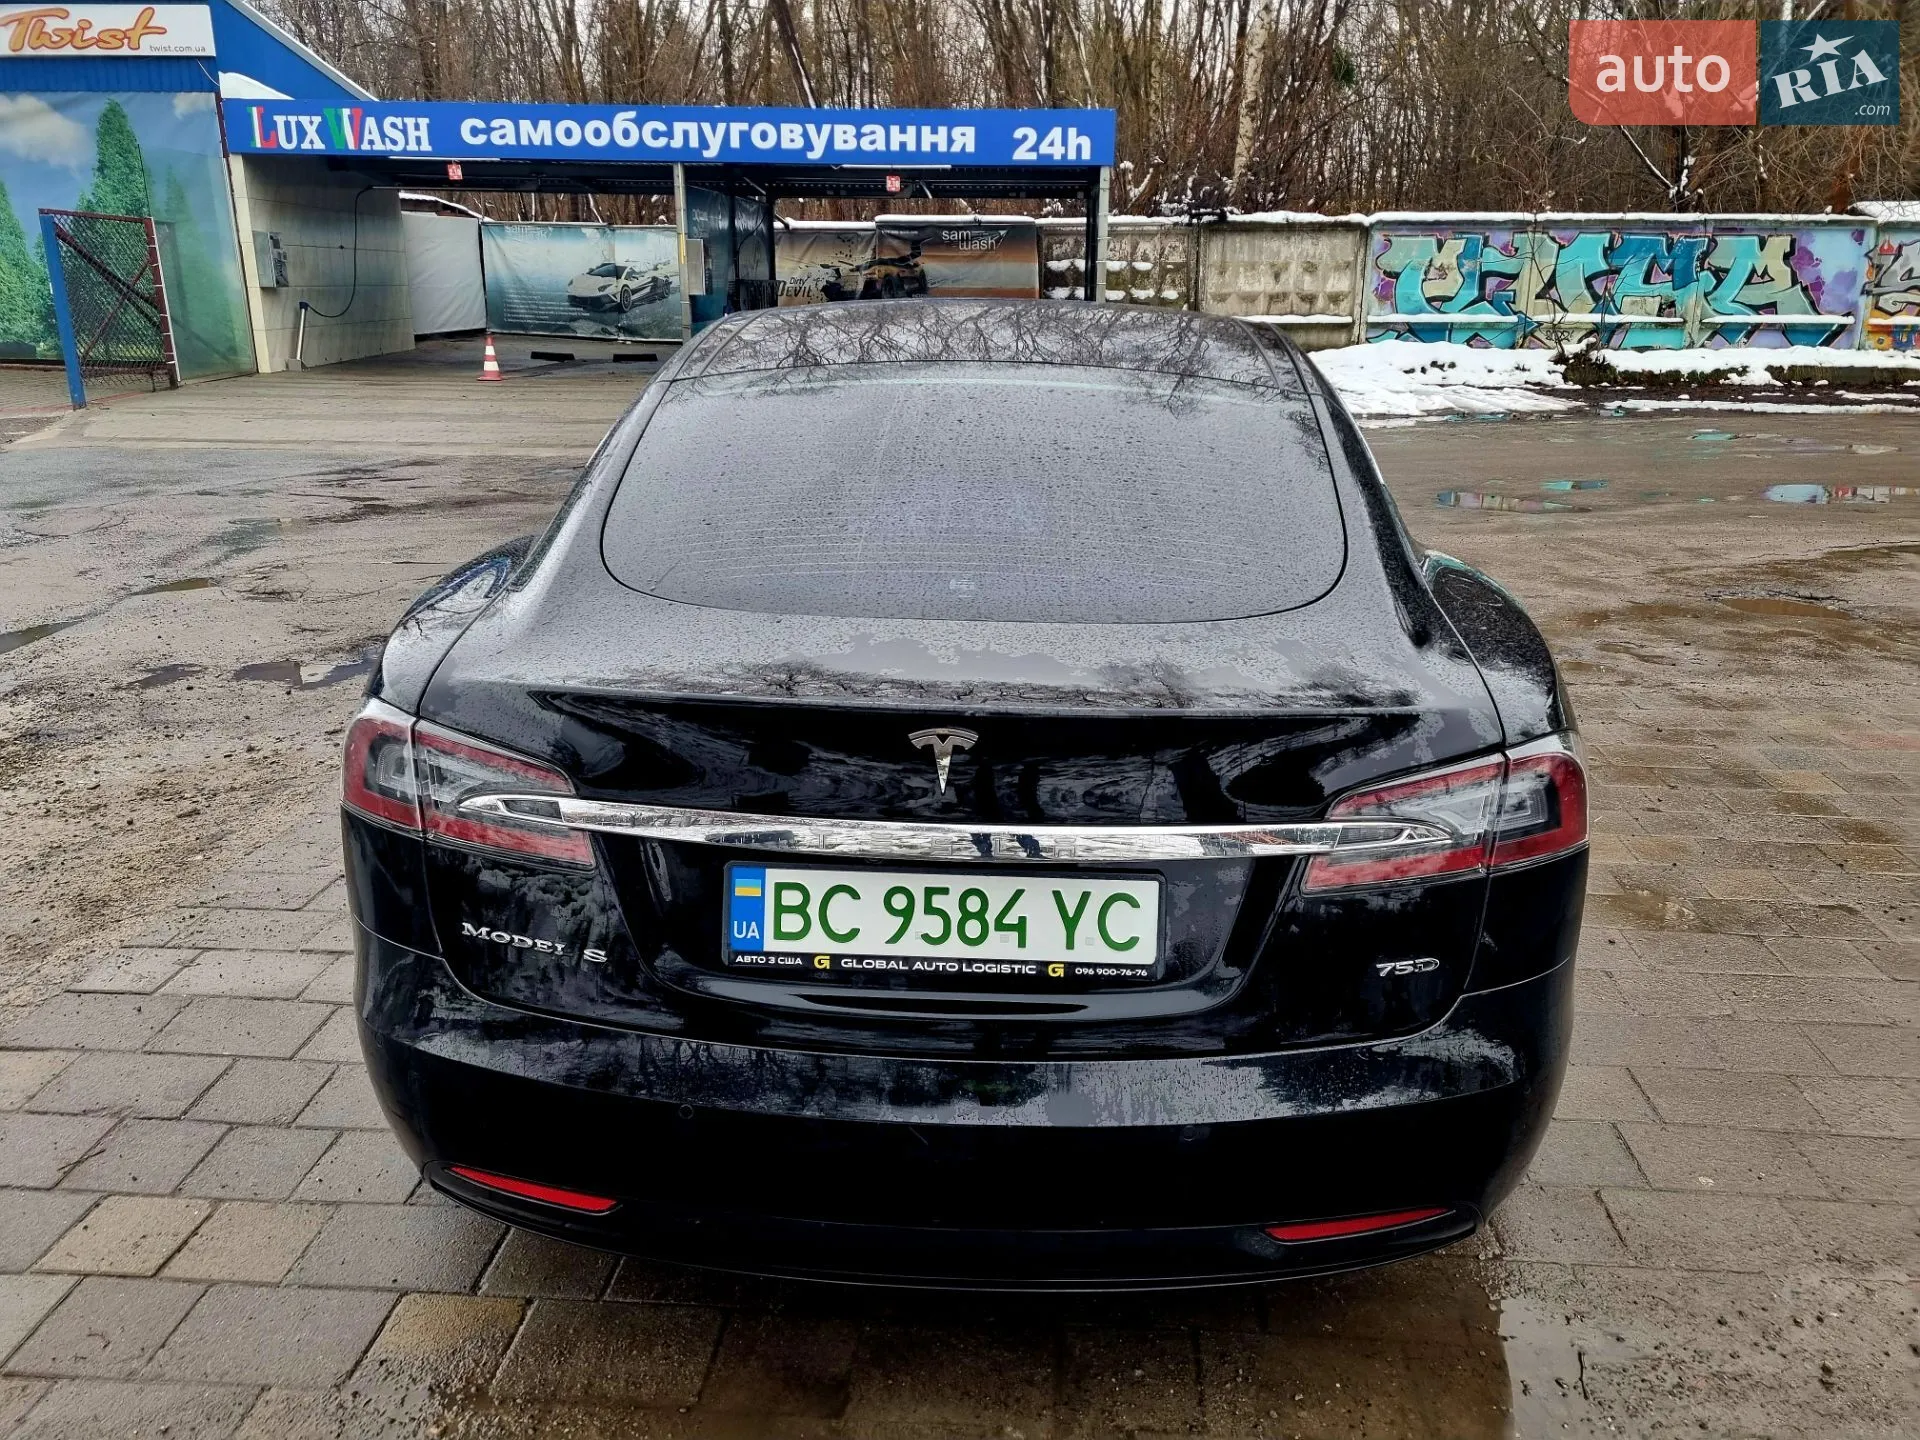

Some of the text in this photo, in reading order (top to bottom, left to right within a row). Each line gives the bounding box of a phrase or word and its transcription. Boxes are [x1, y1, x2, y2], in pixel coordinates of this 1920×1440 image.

[0, 7, 167, 51] Twist
[149, 45, 206, 53] twist.com.ua
[460, 111, 976, 160] самообслуговування
[1011, 126, 1092, 161] 24h
[942, 230, 971, 240] sam
[959, 236, 996, 251] wash
[789, 276, 810, 288] Dirty
[773, 881, 1141, 952] BC 9584 YC
[733, 920, 760, 939] UA
[583, 948, 608, 963] S
[840, 958, 1037, 974] GLOBAL AUTO LOGISTIC
[1075, 967, 1148, 977] 096 900-76-76
[1376, 957, 1440, 977] 75D
